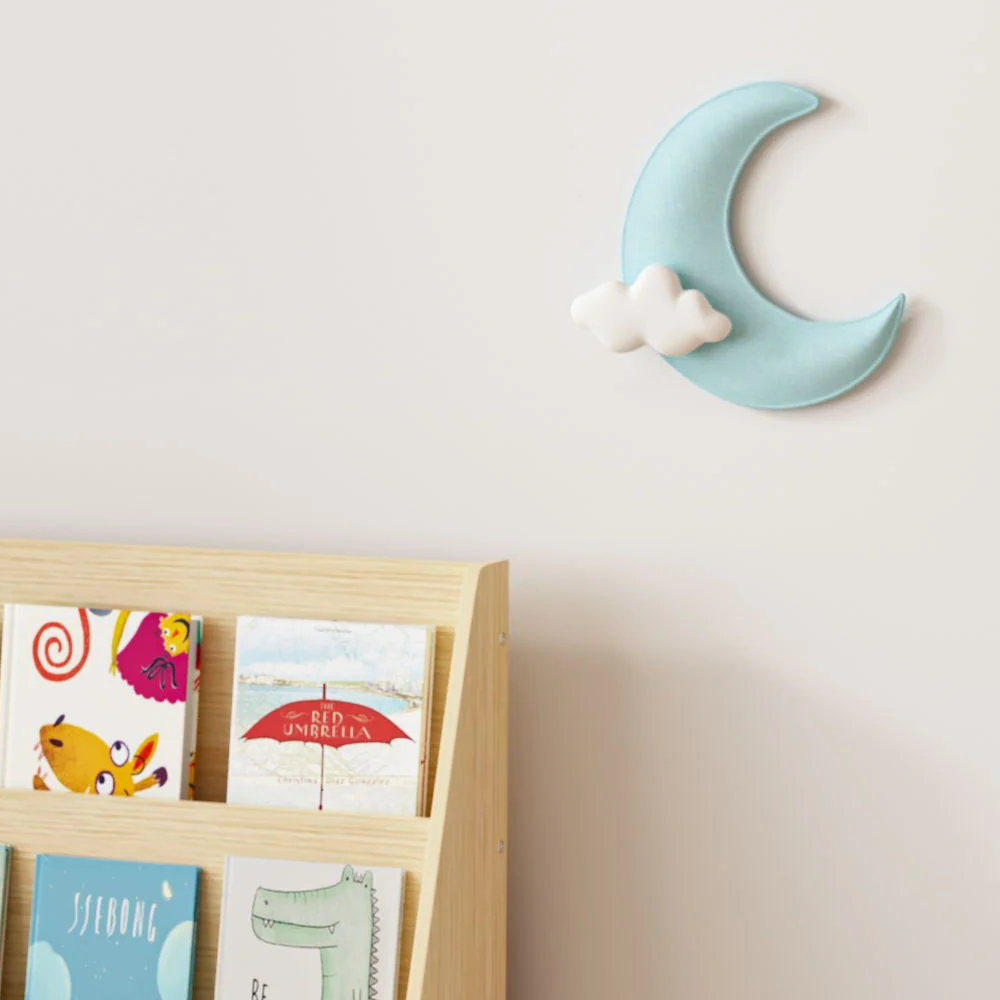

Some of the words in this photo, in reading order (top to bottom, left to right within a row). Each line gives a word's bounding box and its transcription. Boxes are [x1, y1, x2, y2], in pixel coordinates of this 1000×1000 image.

[311, 710, 344, 725] RED
[283, 723, 372, 740] UMBRELLA
[67, 892, 158, 943] SSEBONG
